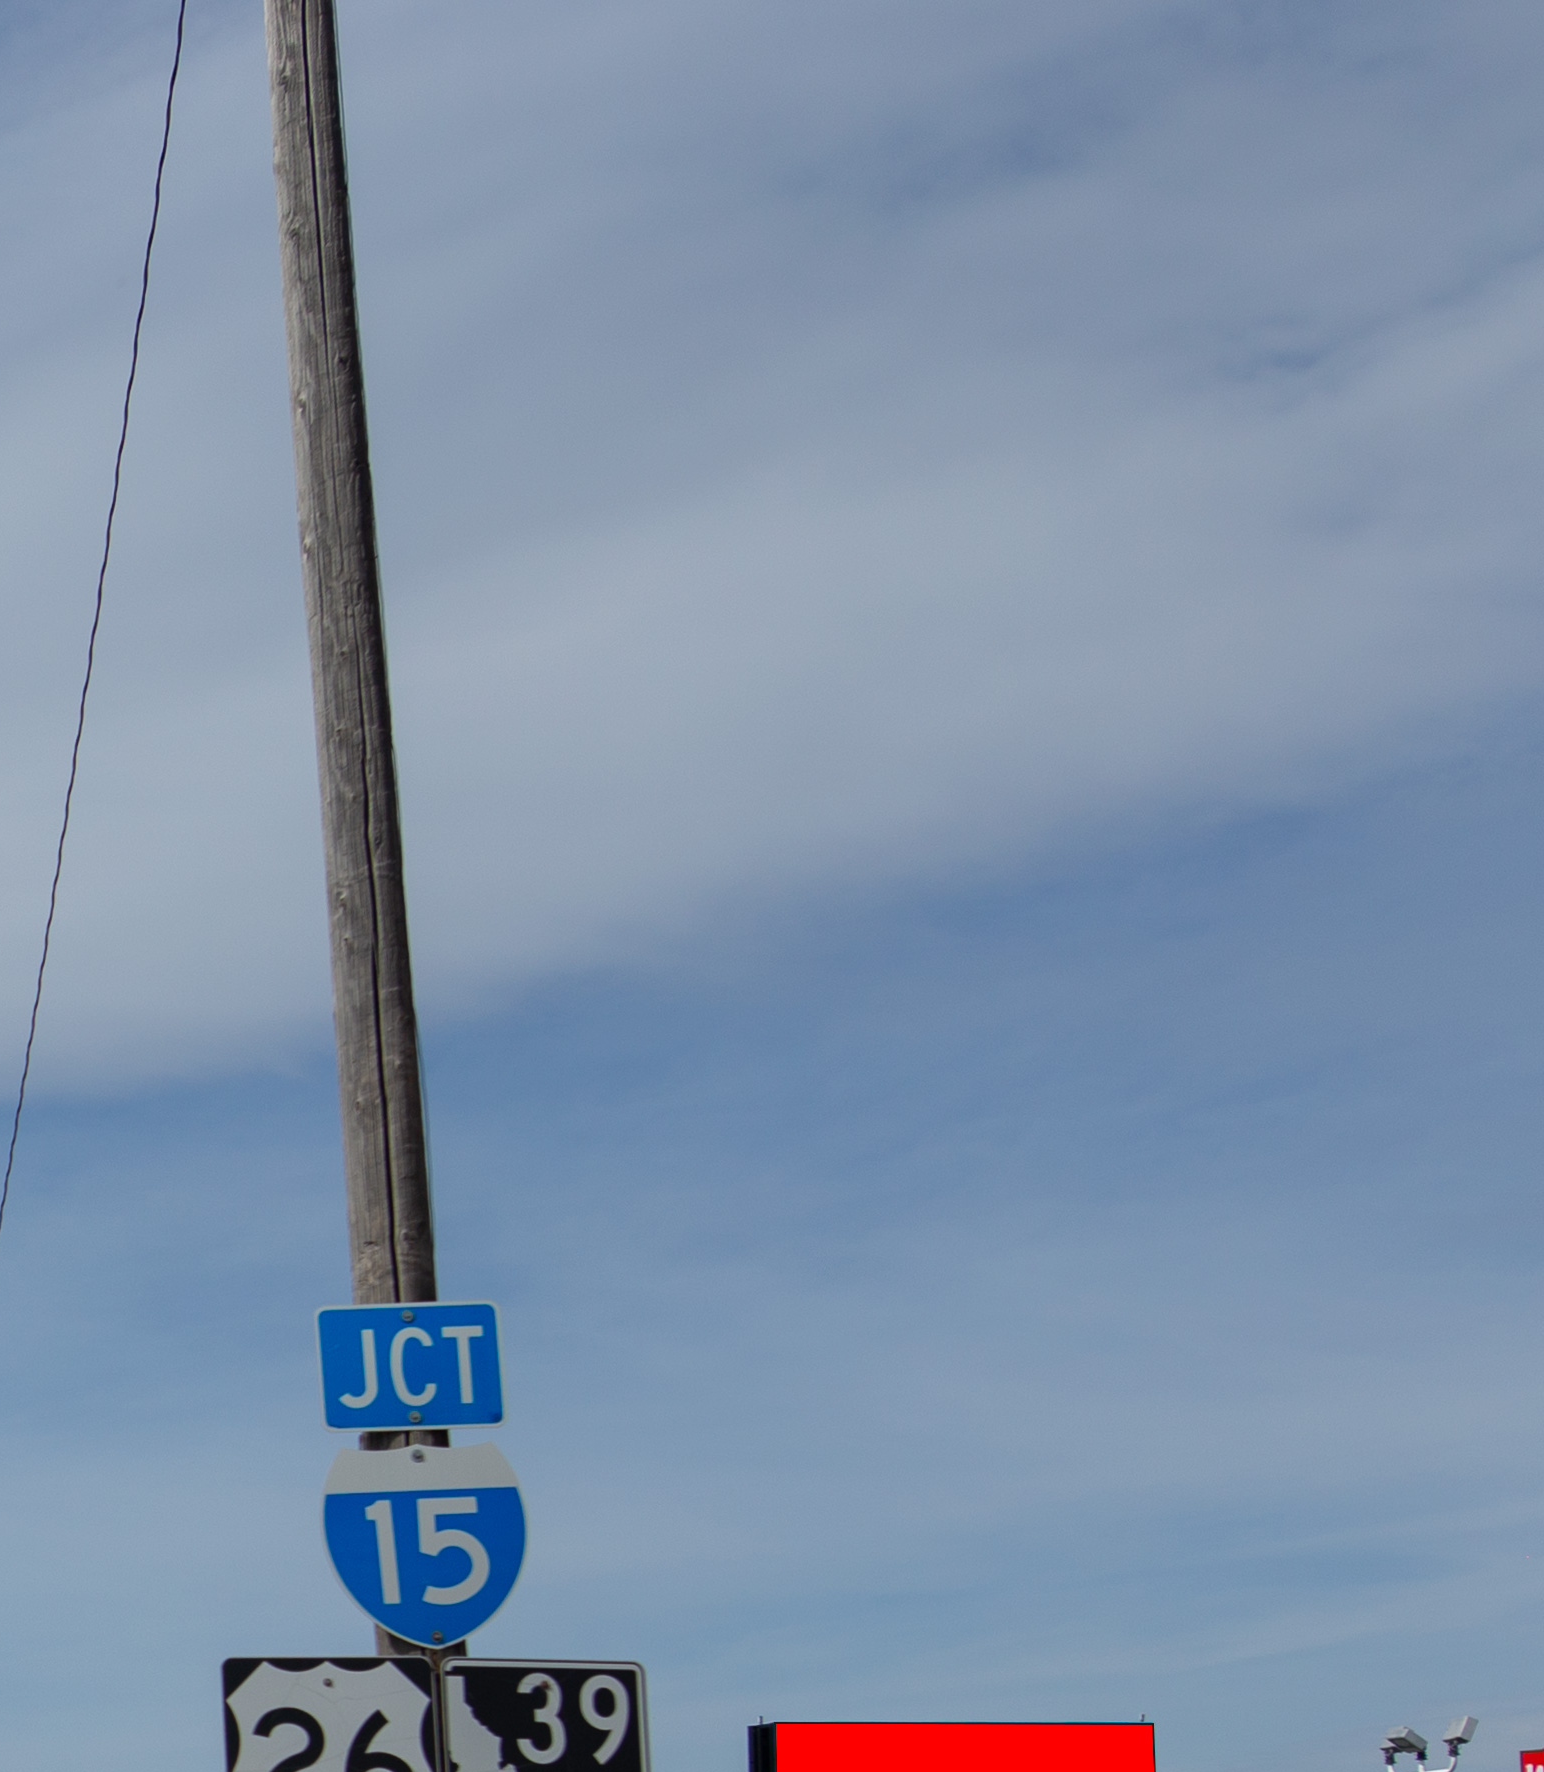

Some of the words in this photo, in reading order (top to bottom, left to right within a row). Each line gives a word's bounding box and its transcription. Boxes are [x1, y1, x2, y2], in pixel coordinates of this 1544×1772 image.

[338, 1325, 484, 1409] JCT
[364, 1496, 491, 1606] 15
[515, 1672, 631, 1766] 39
